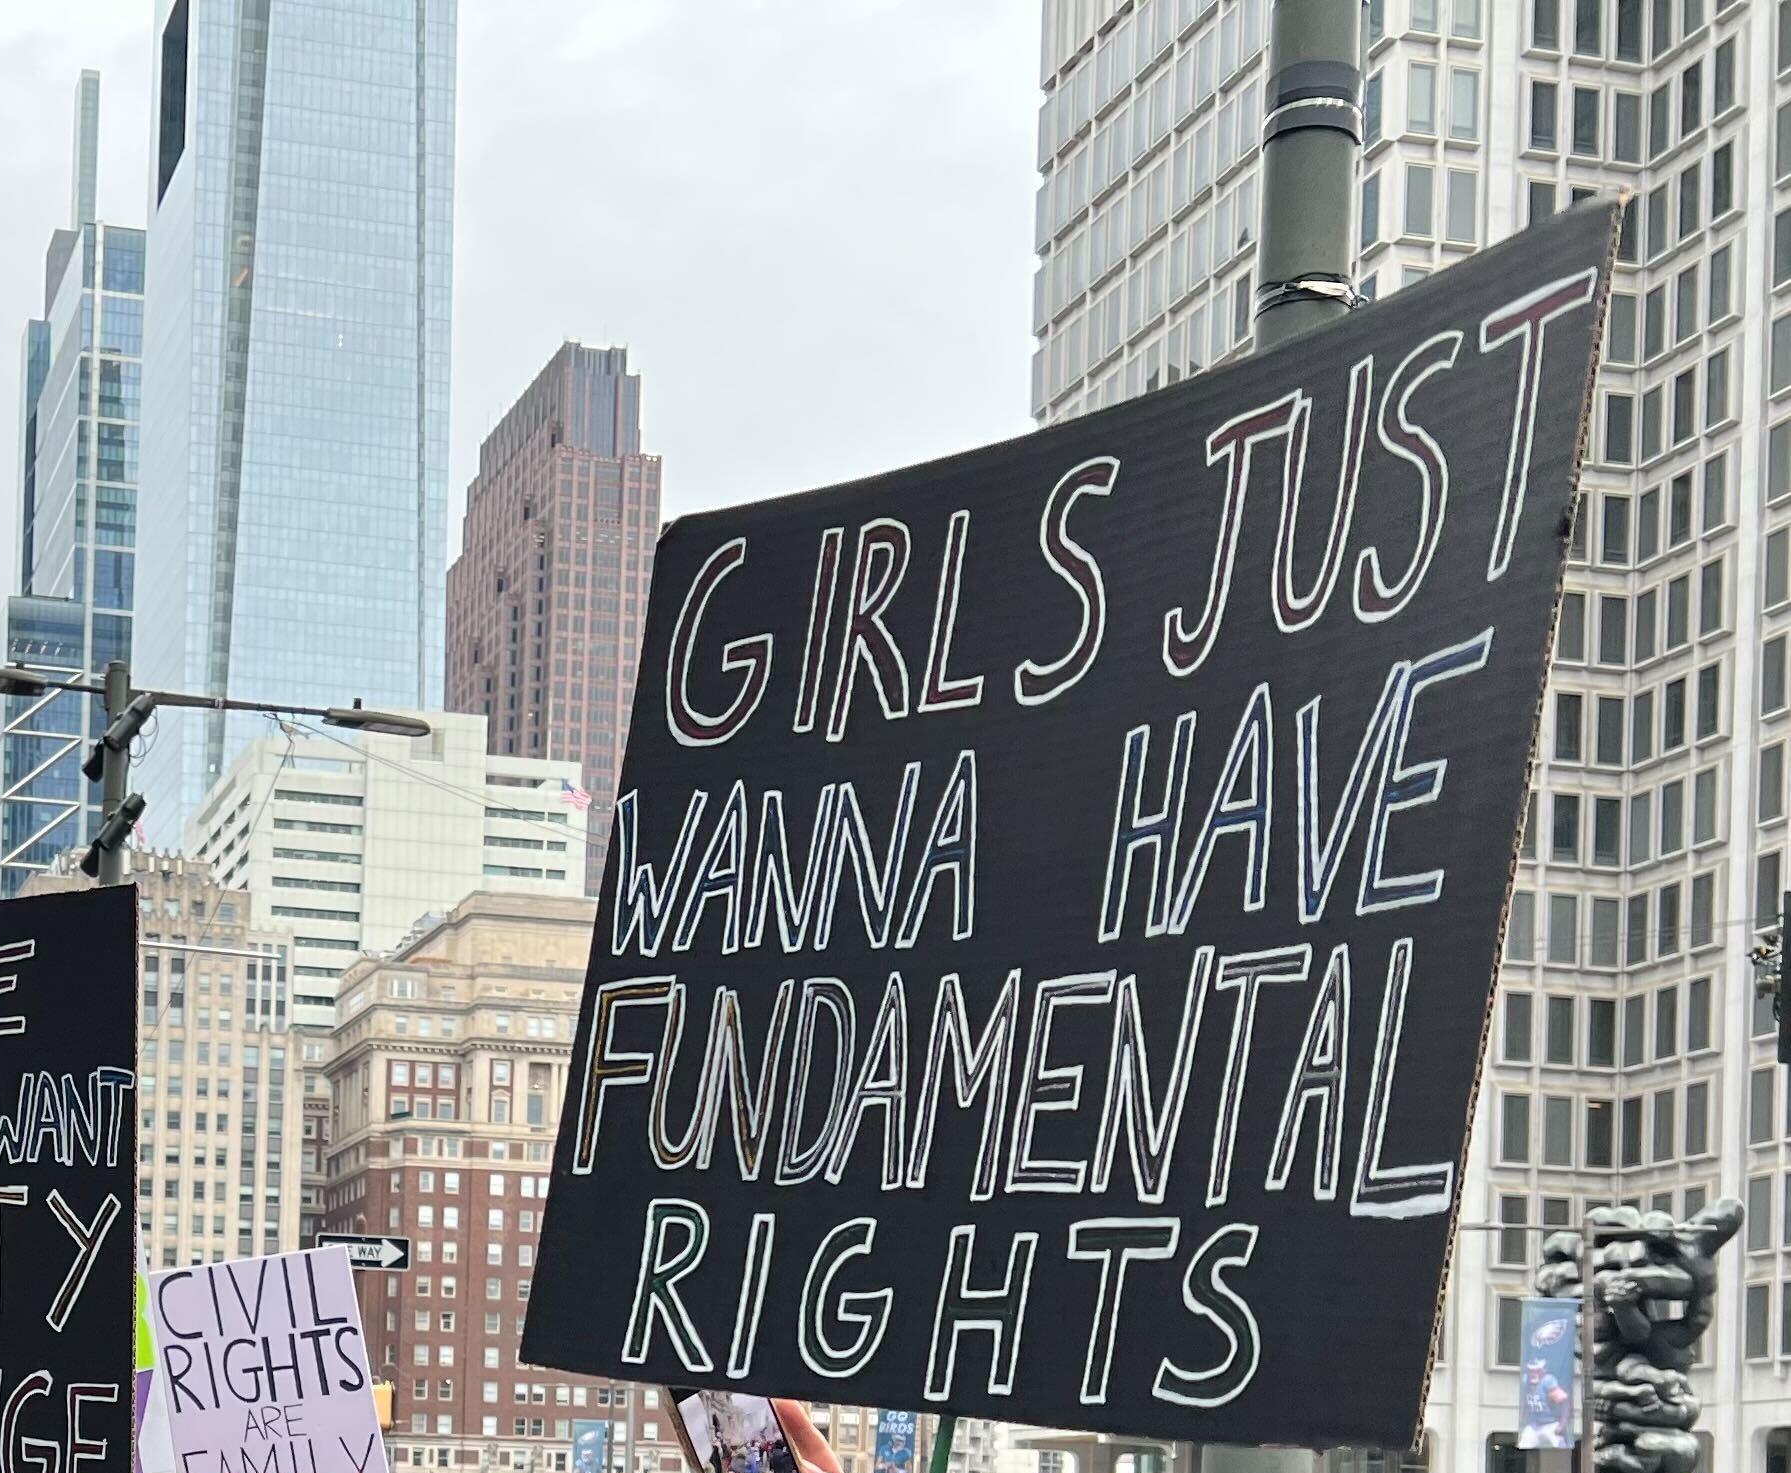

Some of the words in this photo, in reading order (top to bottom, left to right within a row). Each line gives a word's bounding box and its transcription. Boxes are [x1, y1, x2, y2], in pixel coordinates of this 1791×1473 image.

[667, 456, 1120, 746] GIRLS
[1164, 266, 1598, 678] JUST
[611, 749, 979, 958] WANNA
[1098, 626, 1494, 942] HAVE
[572, 936, 1454, 1218] FUNDAMENTAL
[158, 1252, 349, 1341] CIVIL
[357, 1245, 382, 1259] WAY
[621, 1198, 1263, 1408] RIGHTS
[163, 1325, 365, 1414] RIGHTS
[244, 1403, 308, 1443] ARE
[878, 1422, 914, 1435] BIRDS
[886, 1410, 908, 1422] GO
